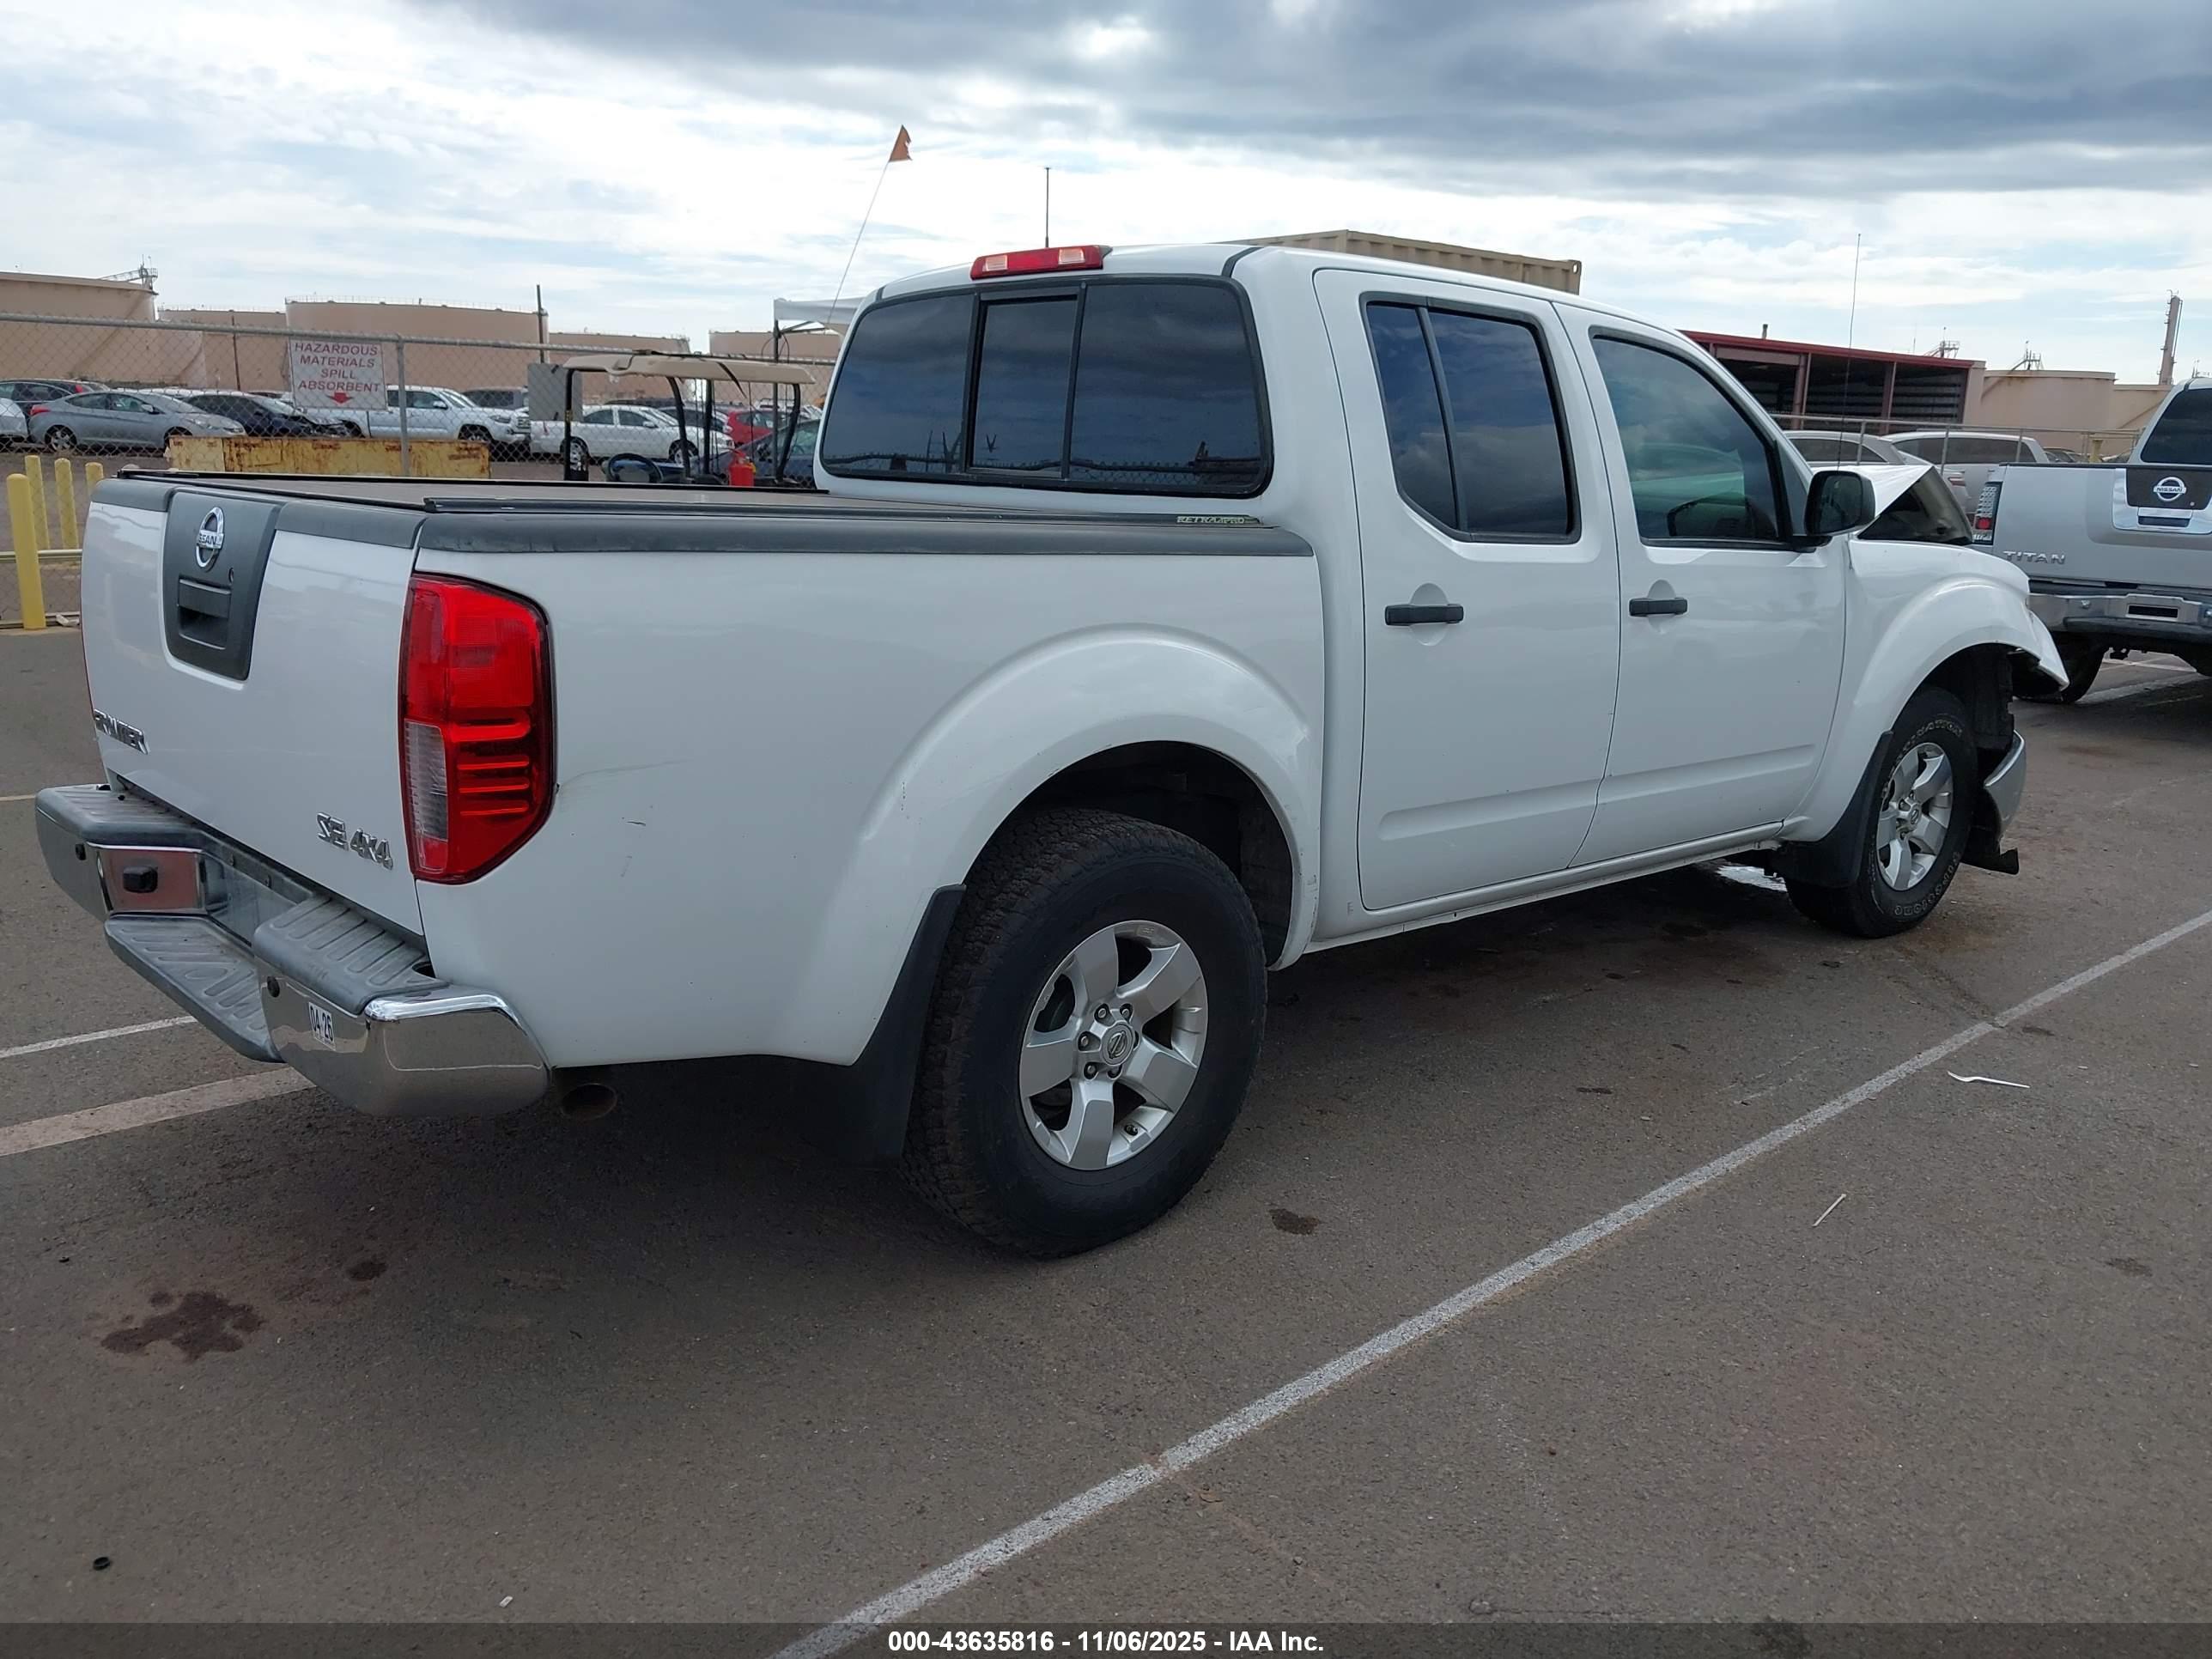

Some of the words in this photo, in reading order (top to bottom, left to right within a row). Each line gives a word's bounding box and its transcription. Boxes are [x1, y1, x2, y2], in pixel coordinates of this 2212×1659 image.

[295, 343, 378, 356] HAZARDOUS
[300, 355, 375, 368] MATERIALS
[320, 368, 357, 379] SPILL
[298, 380, 380, 392] ABSORBENT
[2003, 550, 2065, 564] TITAN
[317, 812, 349, 852] SE
